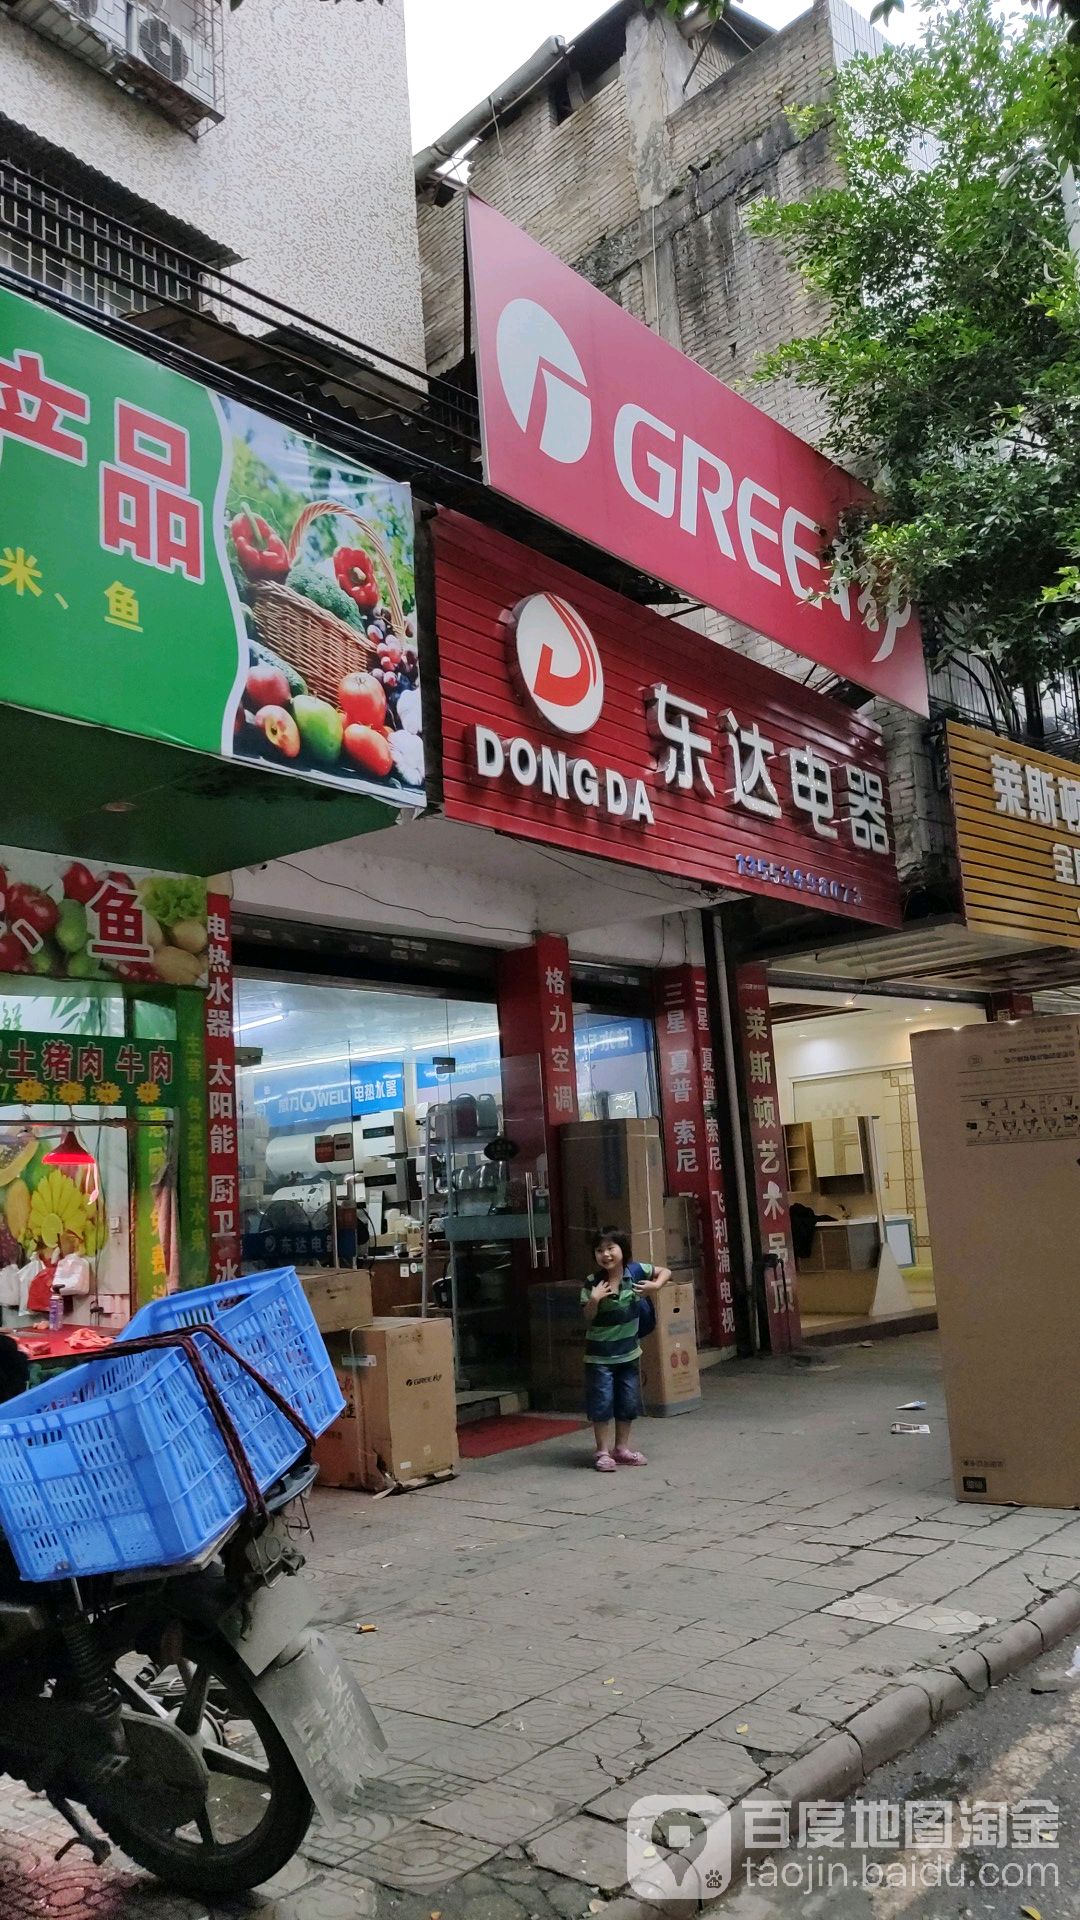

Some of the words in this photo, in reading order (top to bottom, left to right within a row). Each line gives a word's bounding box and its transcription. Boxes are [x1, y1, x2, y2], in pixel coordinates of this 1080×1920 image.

[0, 348, 205, 584] 产品
[614, 403, 823, 611] GREE
[475, 725, 656, 826] DONGDA
[648, 684, 893, 856] 东达电器
[1052, 842, 1080, 886] 全
[205, 912, 232, 1040] 电热水器
[663, 981, 687, 1036] 三星
[693, 980, 709, 1032] 三星
[0, 1037, 105, 1083] 土猪肉
[115, 1043, 174, 1086] 牛肉
[544, 965, 575, 1115] 格力空调
[668, 1049, 693, 1105] 夏普
[208, 1057, 236, 1156] 太阳能
[353, 1080, 398, 1103] 电热水器
[672, 1119, 700, 1174] 索尼
[743, 1005, 796, 1316] 莱斯顿艺术吊顶
[208, 1173, 236, 1240] 厨卫
